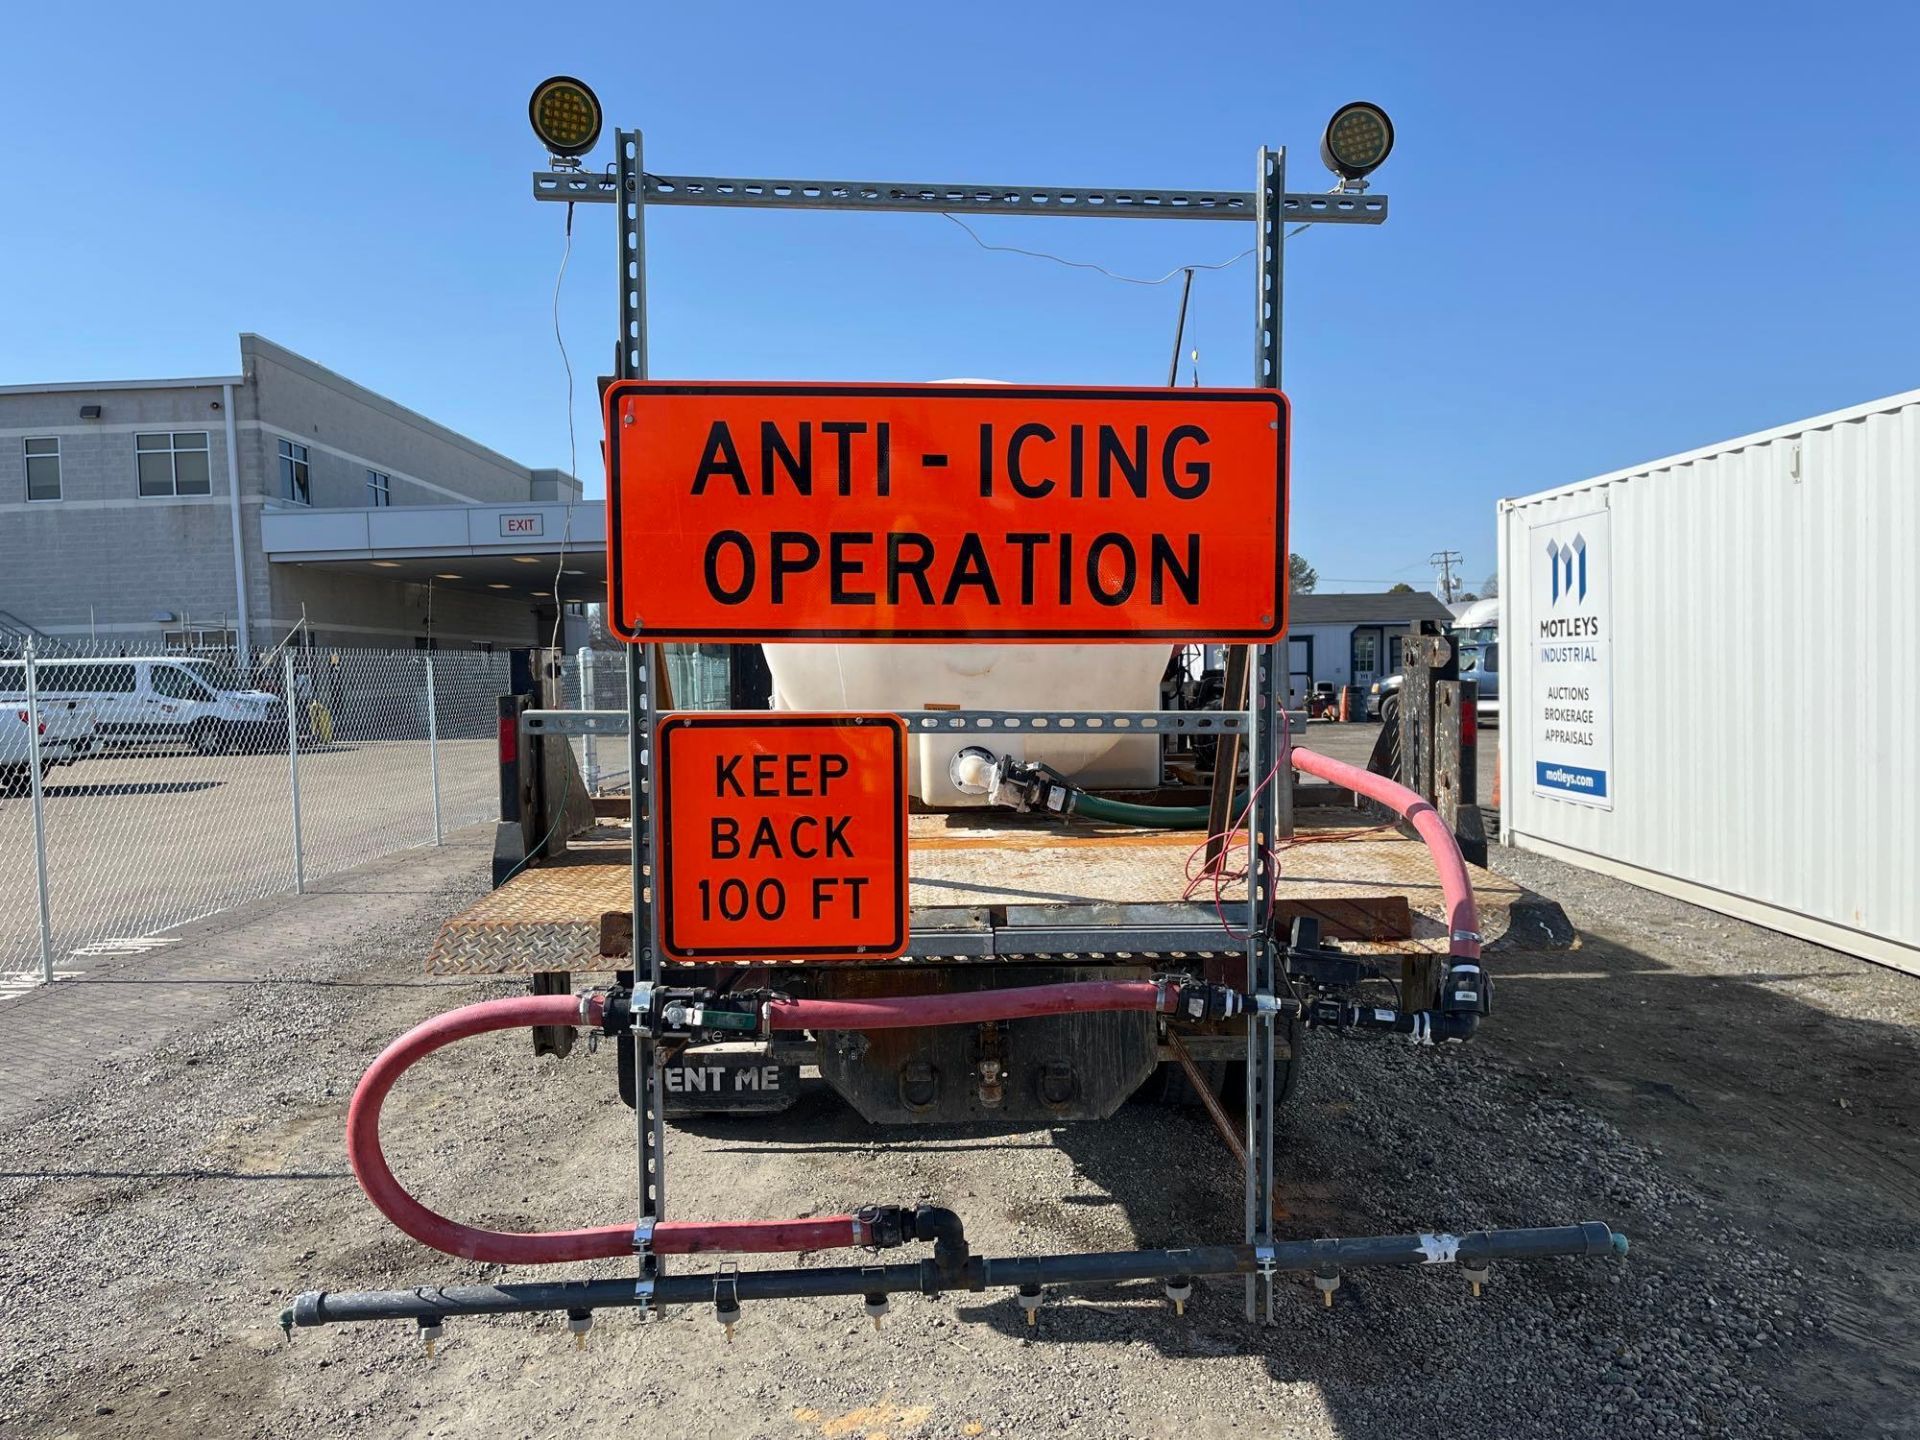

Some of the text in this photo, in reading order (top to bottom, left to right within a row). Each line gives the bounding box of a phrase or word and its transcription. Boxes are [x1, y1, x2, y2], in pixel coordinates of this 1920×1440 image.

[690, 420, 891, 497] ANTI
[978, 422, 1212, 500] ICING
[508, 519, 535, 531] EXIT
[703, 529, 1201, 606] OPERATION
[1540, 616, 1599, 639] MOTLEYS
[1541, 647, 1598, 663] INDUSTRIAL
[1547, 686, 1590, 701] AUCTIONS
[1544, 708, 1594, 724] BROKERAGE
[1545, 729, 1594, 746] APPRAISALS
[715, 754, 849, 798] KEEP
[1545, 768, 1594, 788] motleys.com
[711, 815, 855, 860] BACK
[698, 877, 869, 922] 100 FT
[734, 1065, 780, 1092] ME
